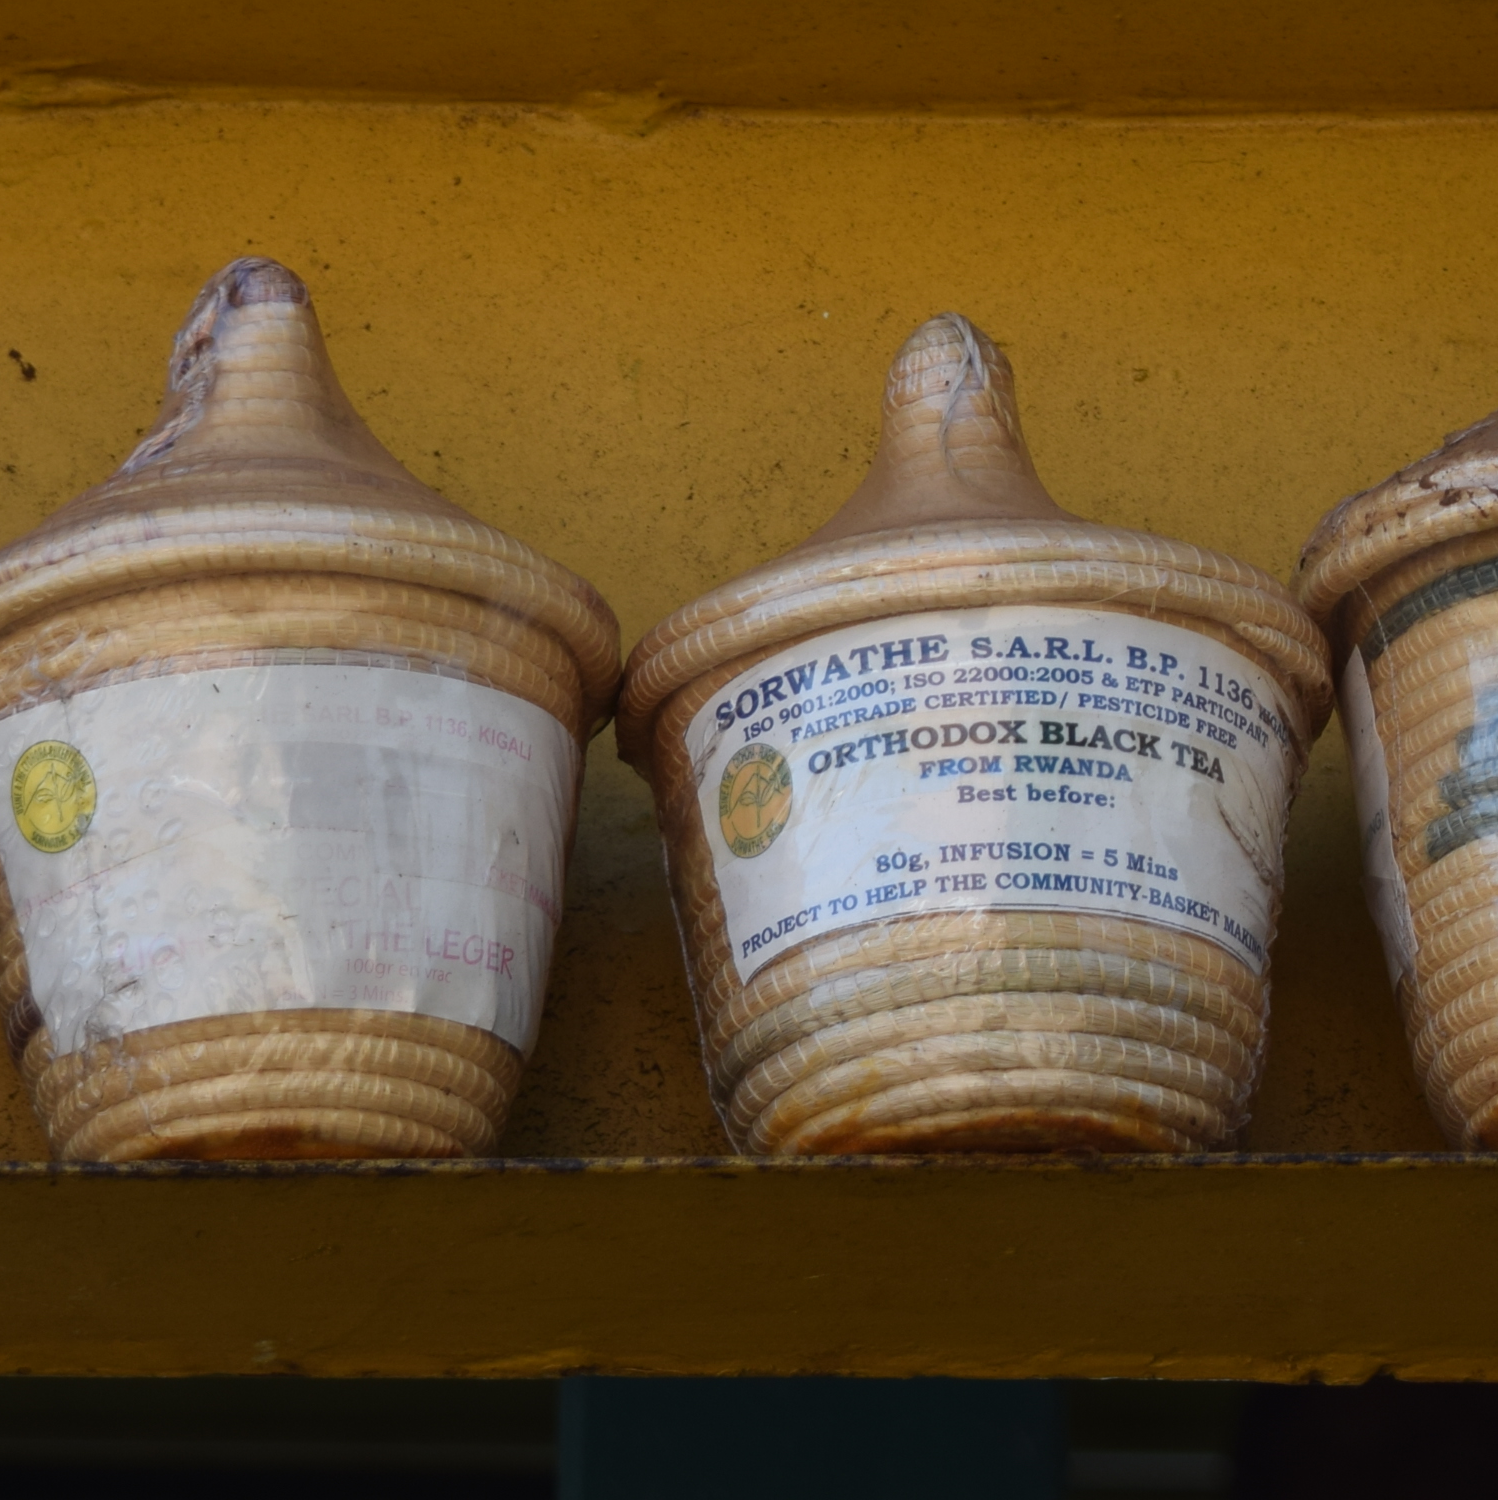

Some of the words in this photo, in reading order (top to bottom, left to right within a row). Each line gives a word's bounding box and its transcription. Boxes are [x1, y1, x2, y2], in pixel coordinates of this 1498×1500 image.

[715, 634, 950, 733] SORWATHE
[971, 636, 1113, 664] S.A.R.L.
[1126, 645, 1185, 681] B.P.
[743, 716, 774, 742] ISO
[779, 678, 896, 724] 9001:2000;
[904, 671, 945, 690] ISO
[953, 666, 1095, 685] 22000:2005
[1101, 672, 1119, 689] &
[1125, 675, 1166, 698] ETP
[1171, 687, 1269, 749] PARTICIPANT
[478, 725, 532, 761] KIGALI
[790, 697, 917, 743] FAIRTRADE
[1078, 692, 1191, 729] PESTICIDE
[1195, 717, 1239, 750] FREE
[808, 720, 1028, 775] ORTHODOX
[1040, 720, 1162, 761] BLACK
[1170, 740, 1225, 785] TEA
[919, 755, 1002, 780] FROM
[1014, 755, 1134, 783] RWANDA
[957, 784, 1017, 803] Best
[1027, 783, 1116, 809] before:
[876, 851, 930, 873] 80g,
[939, 842, 1071, 864] INFUSION
[1103, 848, 1118, 867] 5
[1126, 852, 1179, 881] Mins
[741, 905, 821, 959] PROJECT
[828, 894, 859, 916] TO
[865, 879, 927, 906] HELP
[934, 873, 987, 893] THE
[346, 958, 394, 979] 100gr
[425, 965, 452, 984] vrac
[426, 928, 514, 980] LEGER
